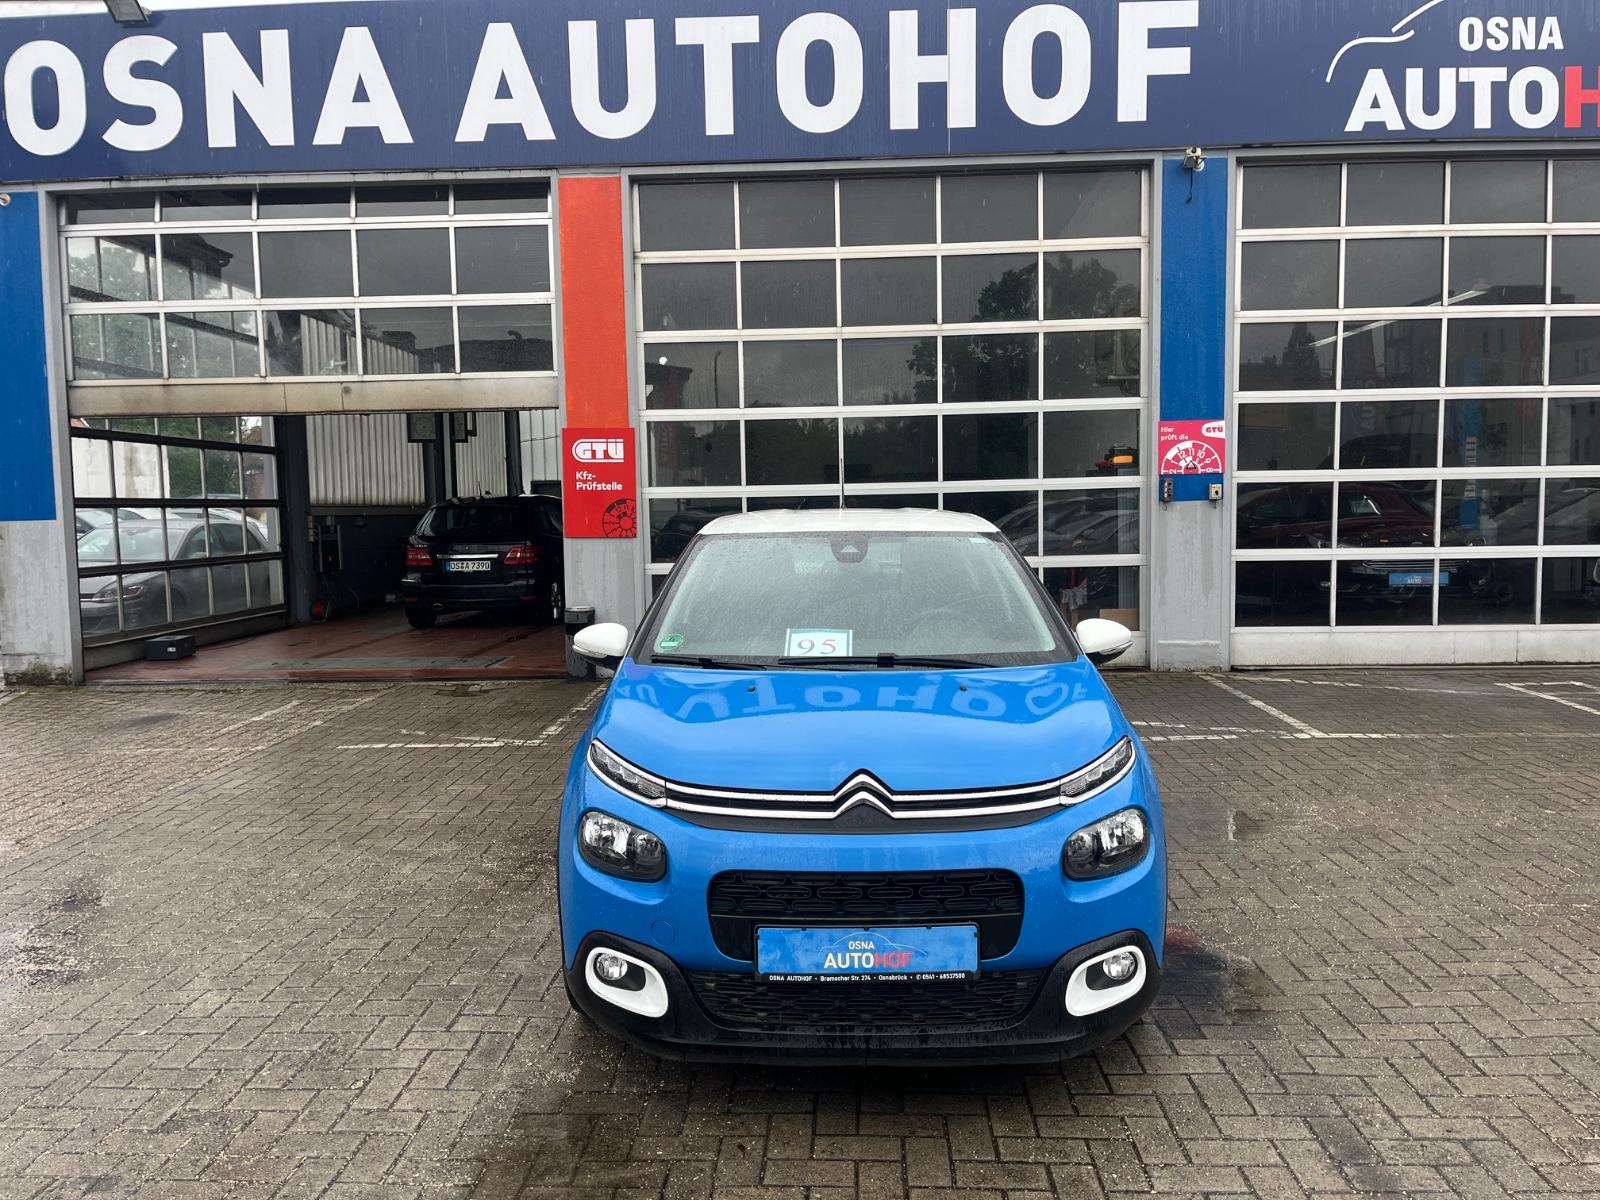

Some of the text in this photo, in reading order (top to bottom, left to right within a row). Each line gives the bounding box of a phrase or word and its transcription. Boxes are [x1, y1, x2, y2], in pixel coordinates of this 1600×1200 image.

[1459, 16, 1564, 51] OSNA
[4, 0, 1199, 156] OSNA AUTOHOF
[576, 471, 596, 480] Kfz-
[576, 482, 623, 490] Prüfstelle
[797, 639, 836, 655] 95
[849, 941, 875, 950] OSNA
[824, 951, 912, 969] AUTOHOF
